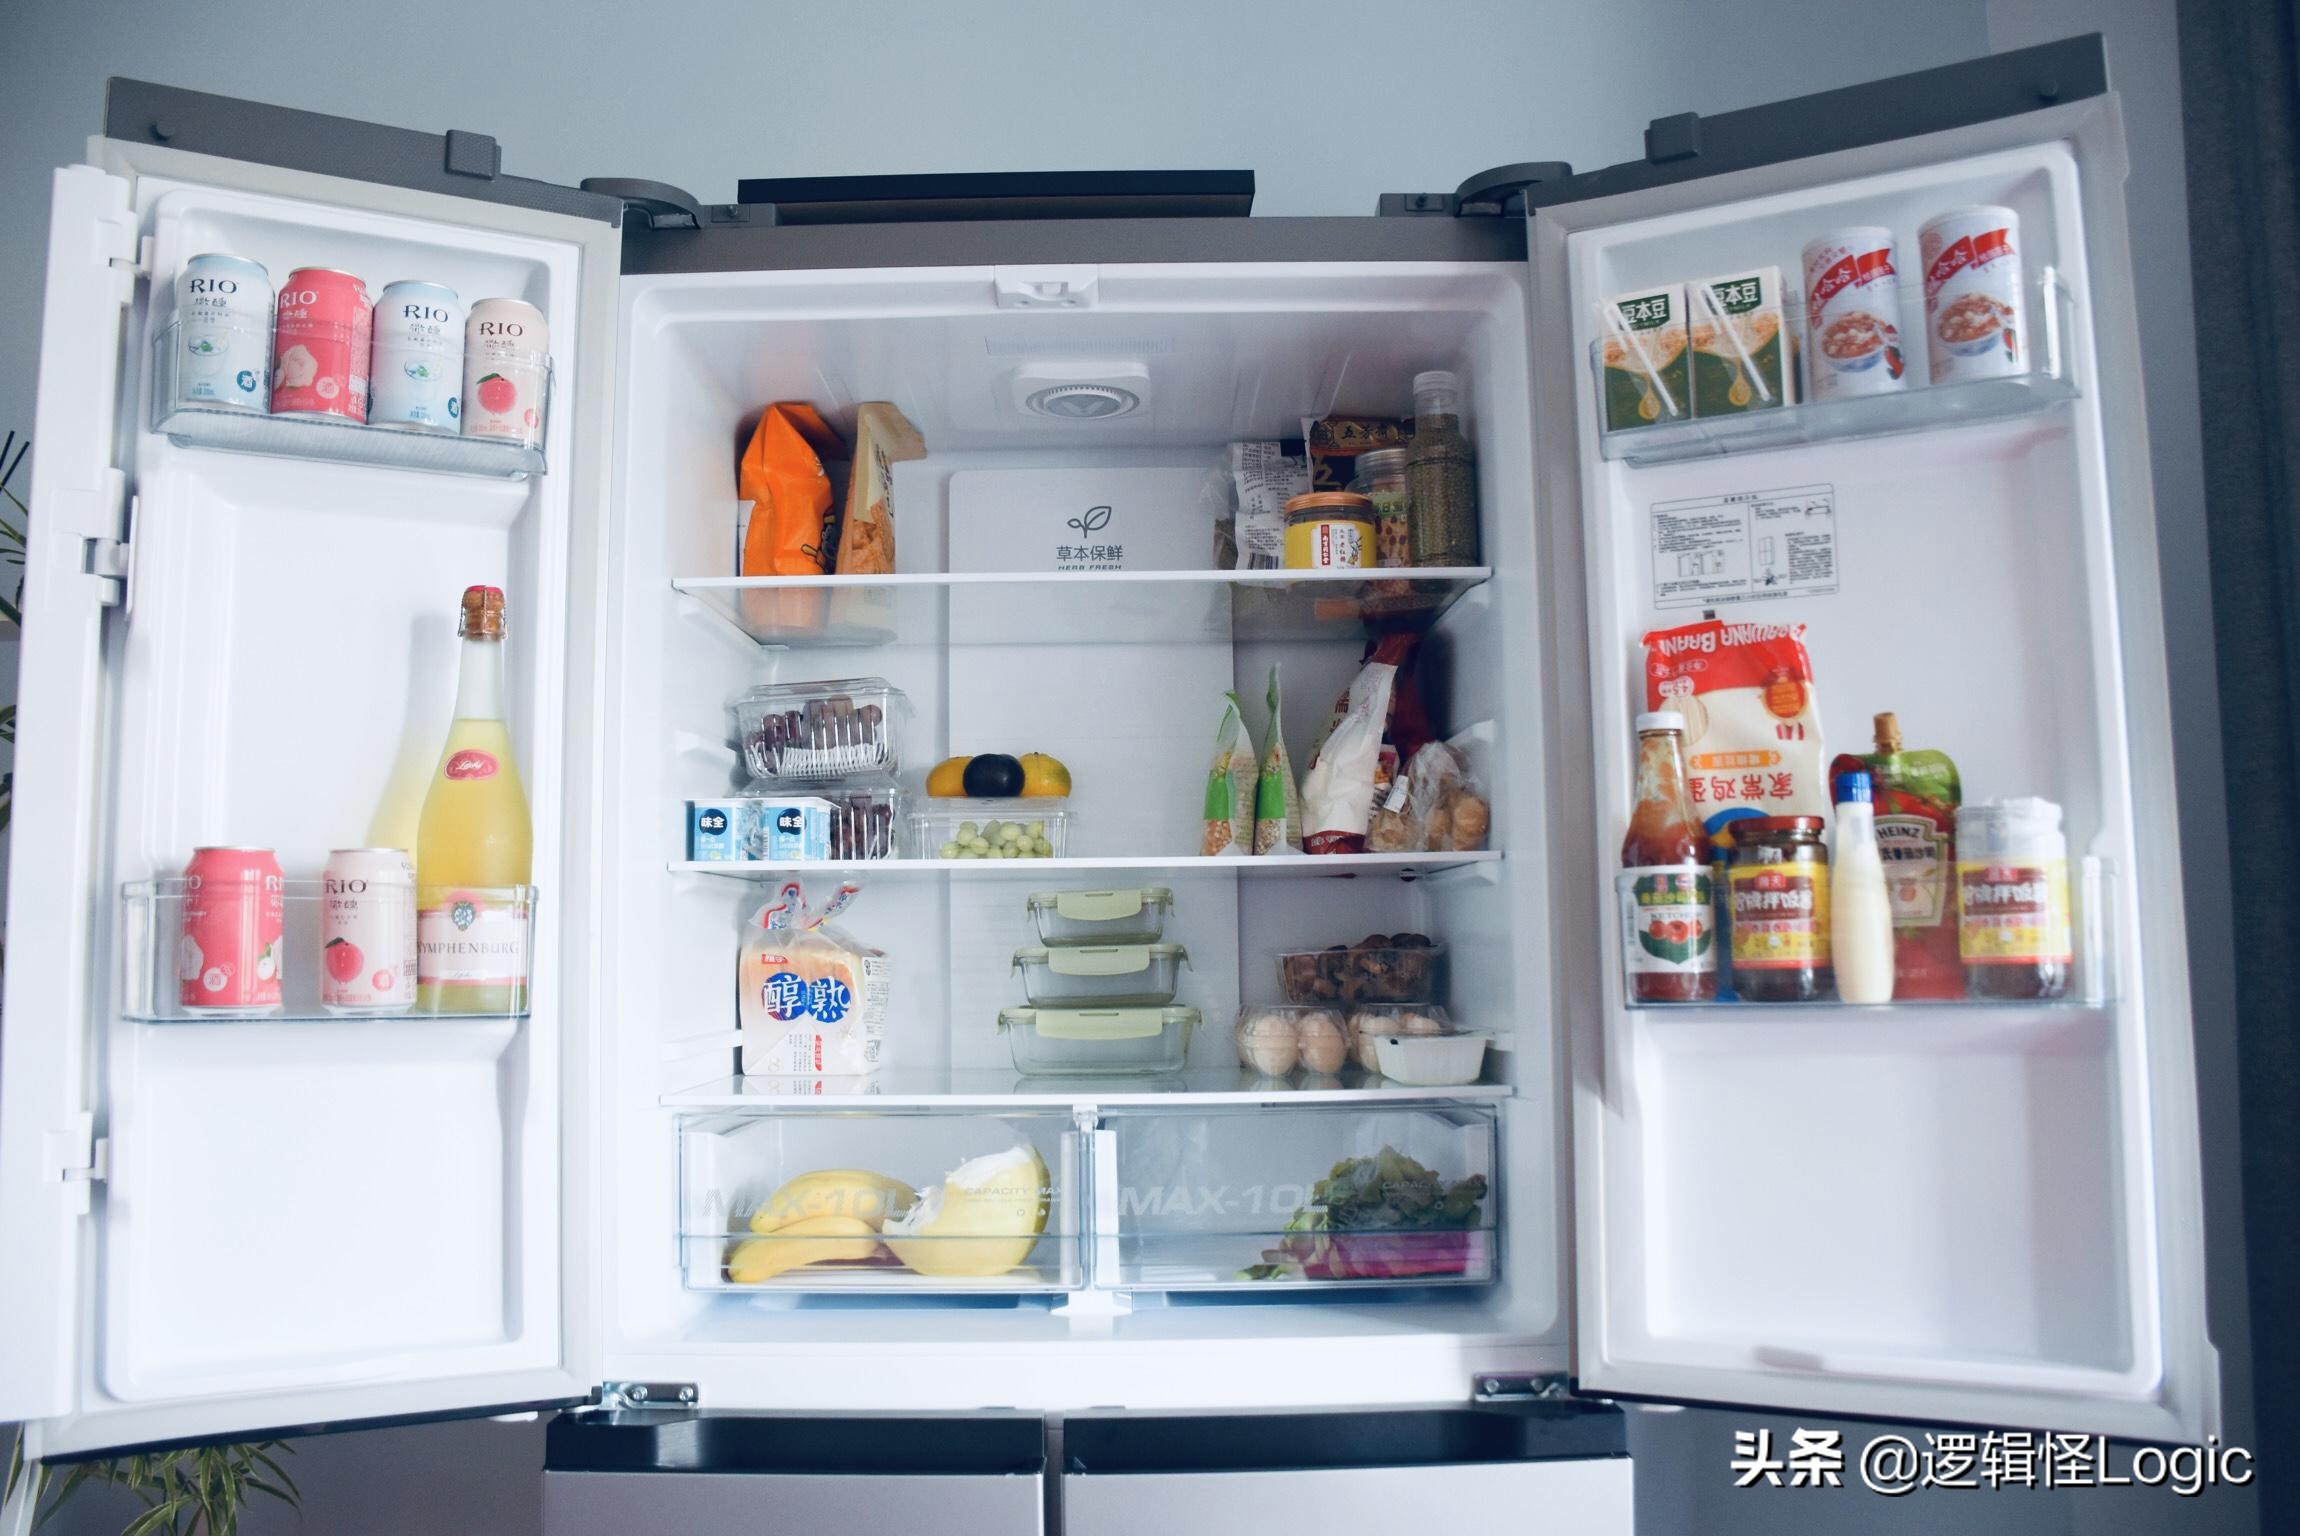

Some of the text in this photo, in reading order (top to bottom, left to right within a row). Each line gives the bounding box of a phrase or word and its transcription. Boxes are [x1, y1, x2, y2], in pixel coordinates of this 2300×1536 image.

[189, 278, 238, 294] RIO
[1712, 281, 1759, 308] 豆本豆
[280, 289, 318, 308] RIO
[403, 304, 449, 323] RIO
[1620, 298, 1668, 324] 豆本豆
[480, 321, 524, 337] RIO
[1056, 545, 1123, 561] 草本保鲜
[1688, 772, 1793, 803] 家常鸡蛋
[700, 817, 726, 829] 味全
[779, 817, 804, 829] 味全
[1876, 825, 1920, 839] HEINZ
[325, 879, 366, 894] RIO
[763, 974, 851, 1018] 醇熟
[964, 1187, 1027, 1195] CAPACITY
[1119, 1184, 1329, 1215] MAX-10L
[702, 1187, 913, 1217] MAX-10L
